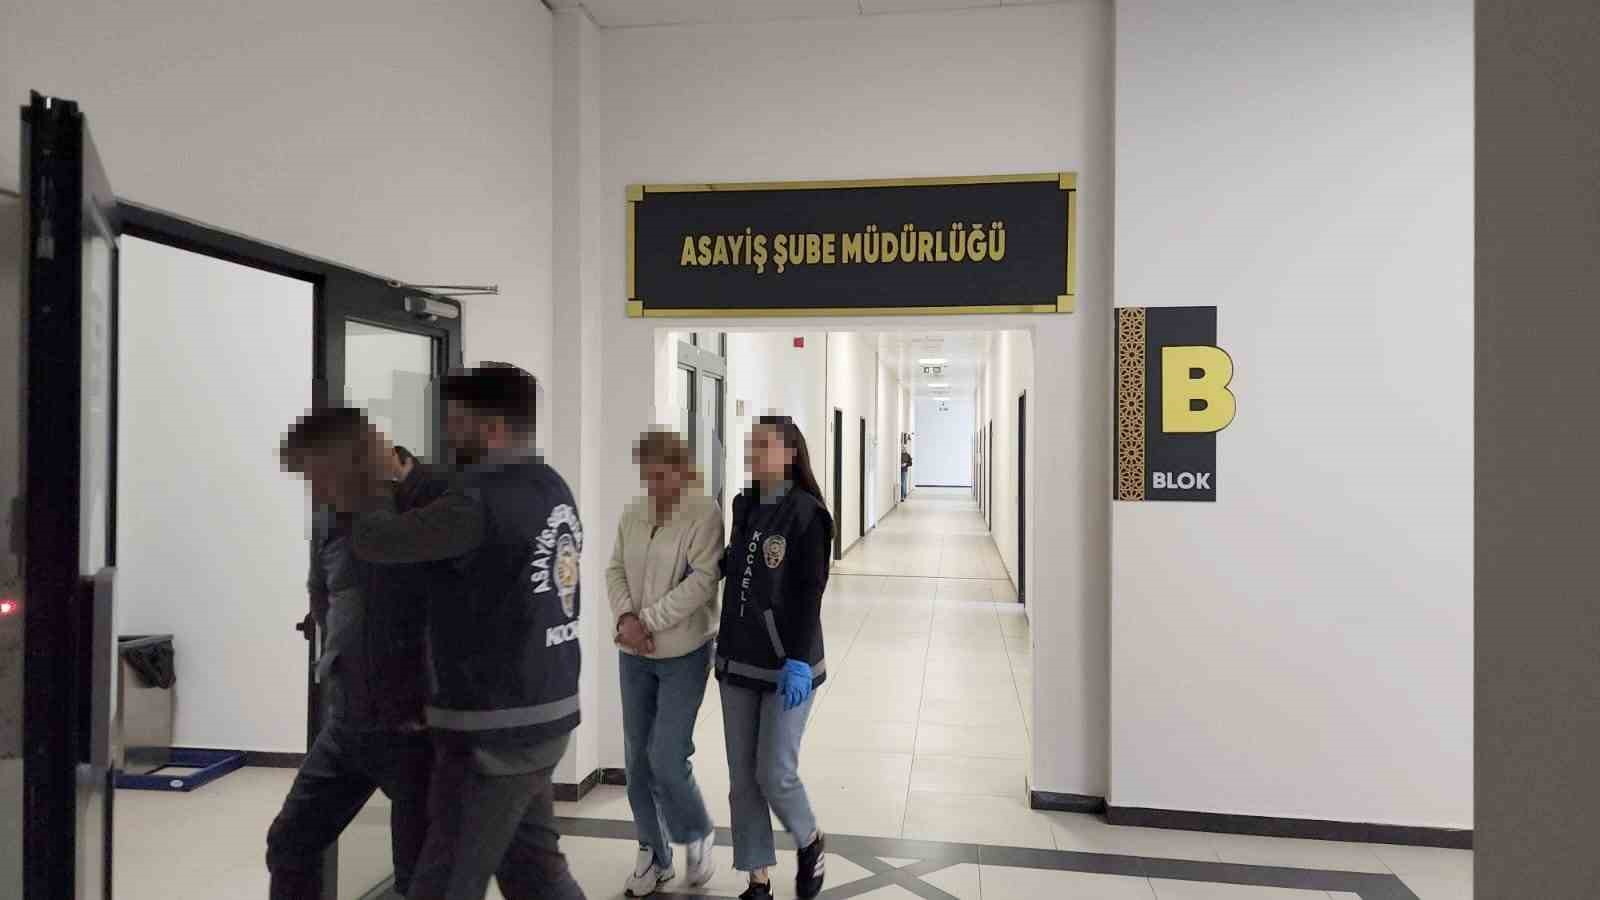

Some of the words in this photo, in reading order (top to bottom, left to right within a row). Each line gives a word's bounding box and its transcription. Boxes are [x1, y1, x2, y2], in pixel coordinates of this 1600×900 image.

[680, 227, 768, 275] ASAYİŞ
[773, 233, 836, 274] ŞUBE
[841, 221, 1007, 264] MÜDÜRLÜĞÜ
[1162, 345, 1236, 433] B
[1152, 471, 1211, 490] BLOK
